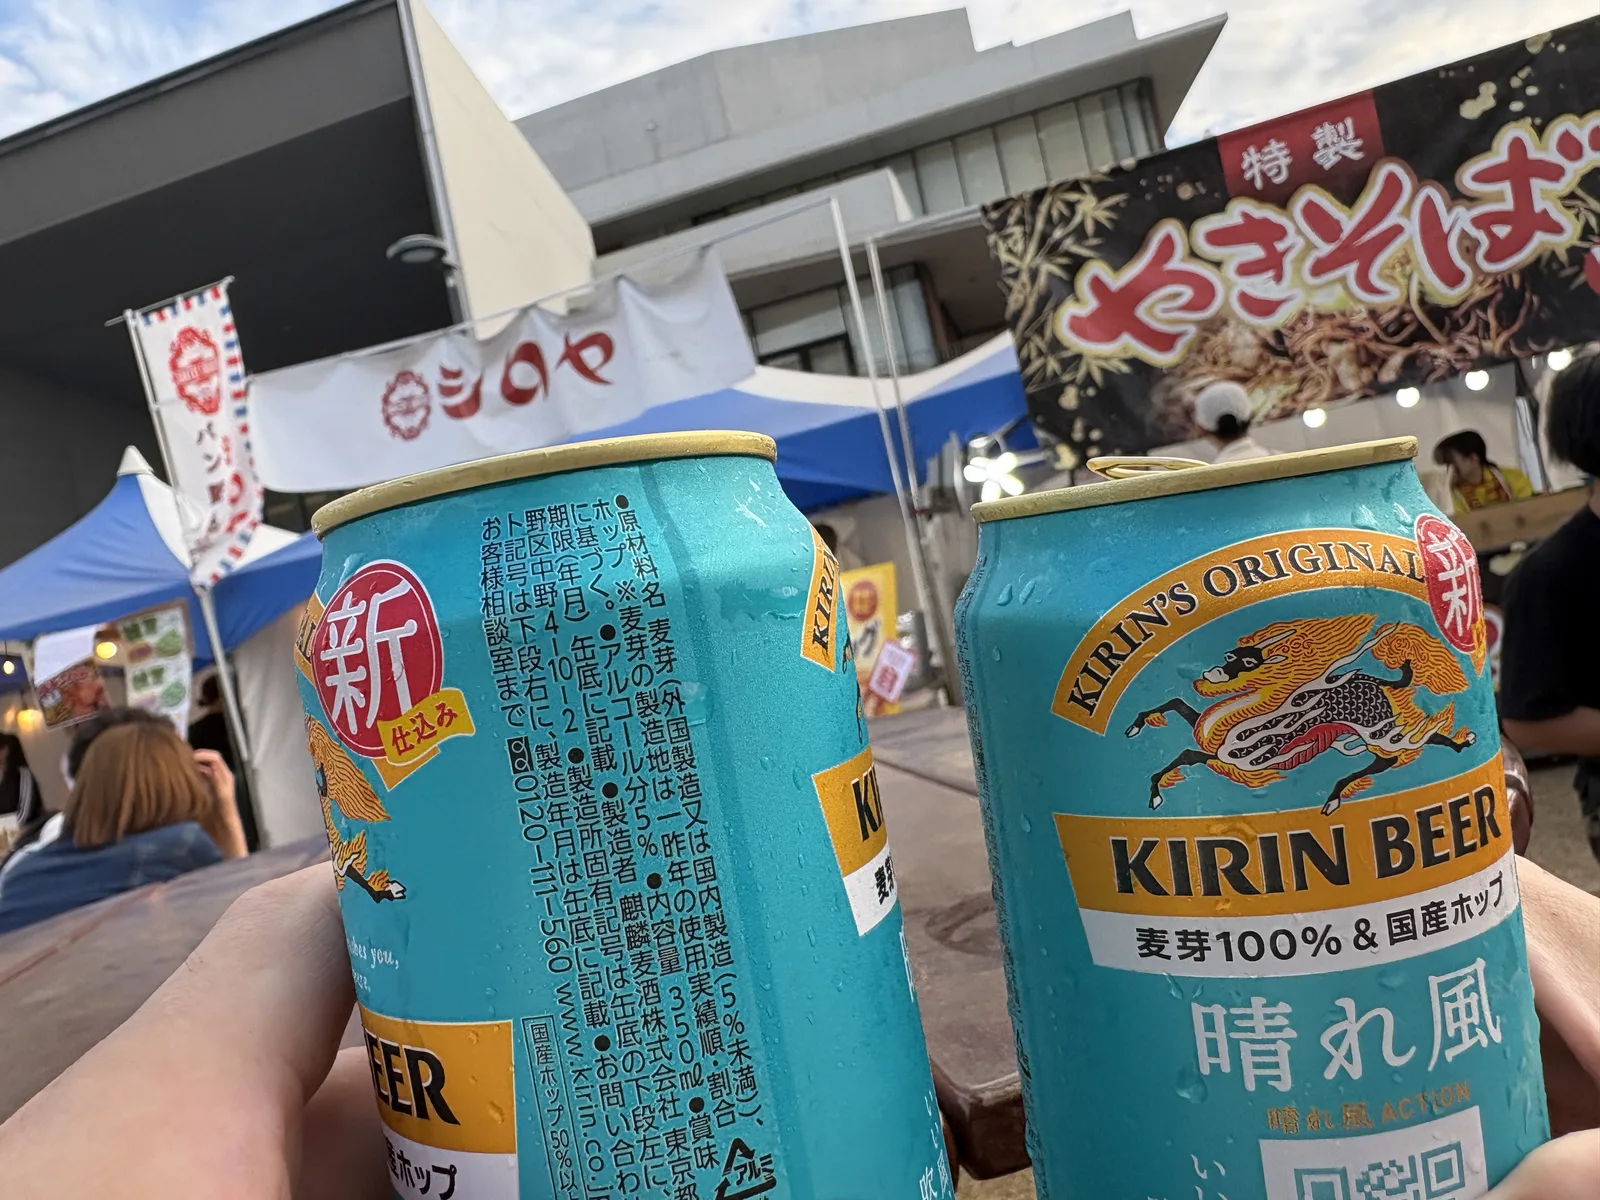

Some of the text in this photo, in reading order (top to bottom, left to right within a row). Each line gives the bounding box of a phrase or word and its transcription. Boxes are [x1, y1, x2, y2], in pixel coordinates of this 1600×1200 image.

[1240, 115, 1366, 192] 特製
[1064, 120, 1600, 357] やきそば
[592, 498, 627, 568] ホップ
[617, 509, 667, 608] 原材料名
[1427, 528, 1482, 637] 新
[320, 578, 418, 734] 新
[1067, 541, 1425, 717] KIRIN'S ORIGINAL
[391, 702, 458, 756] 仕込み
[481, 517, 525, 727] お客様相談室まで
[514, 774, 573, 974] 0120-111-560
[547, 504, 590, 622] 期限（年月）
[571, 635, 618, 773] 缶底に記載
[600, 798, 637, 884] 製造者
[619, 892, 684, 1121] 麒麟麦酒株式会社
[570, 502, 614, 610] に基づく。
[600, 642, 658, 859] アルコール分5%
[646, 891, 684, 976] 内容量
[688, 1111, 720, 1170] 賞味
[1109, 784, 1502, 897] KIRIN BEER
[1135, 871, 1504, 964] 麦芽100% & 国産ホップ
[363, 1028, 462, 1126] EER
[531, 1023, 565, 1126] 国産ホップ
[1191, 957, 1502, 1092] 晴れ風
[595, 1053, 641, 1200] お問い合わ
[1267, 1081, 1471, 1135] 晴れ風 ACTION
[734, 1153, 775, 1187] アルミ
